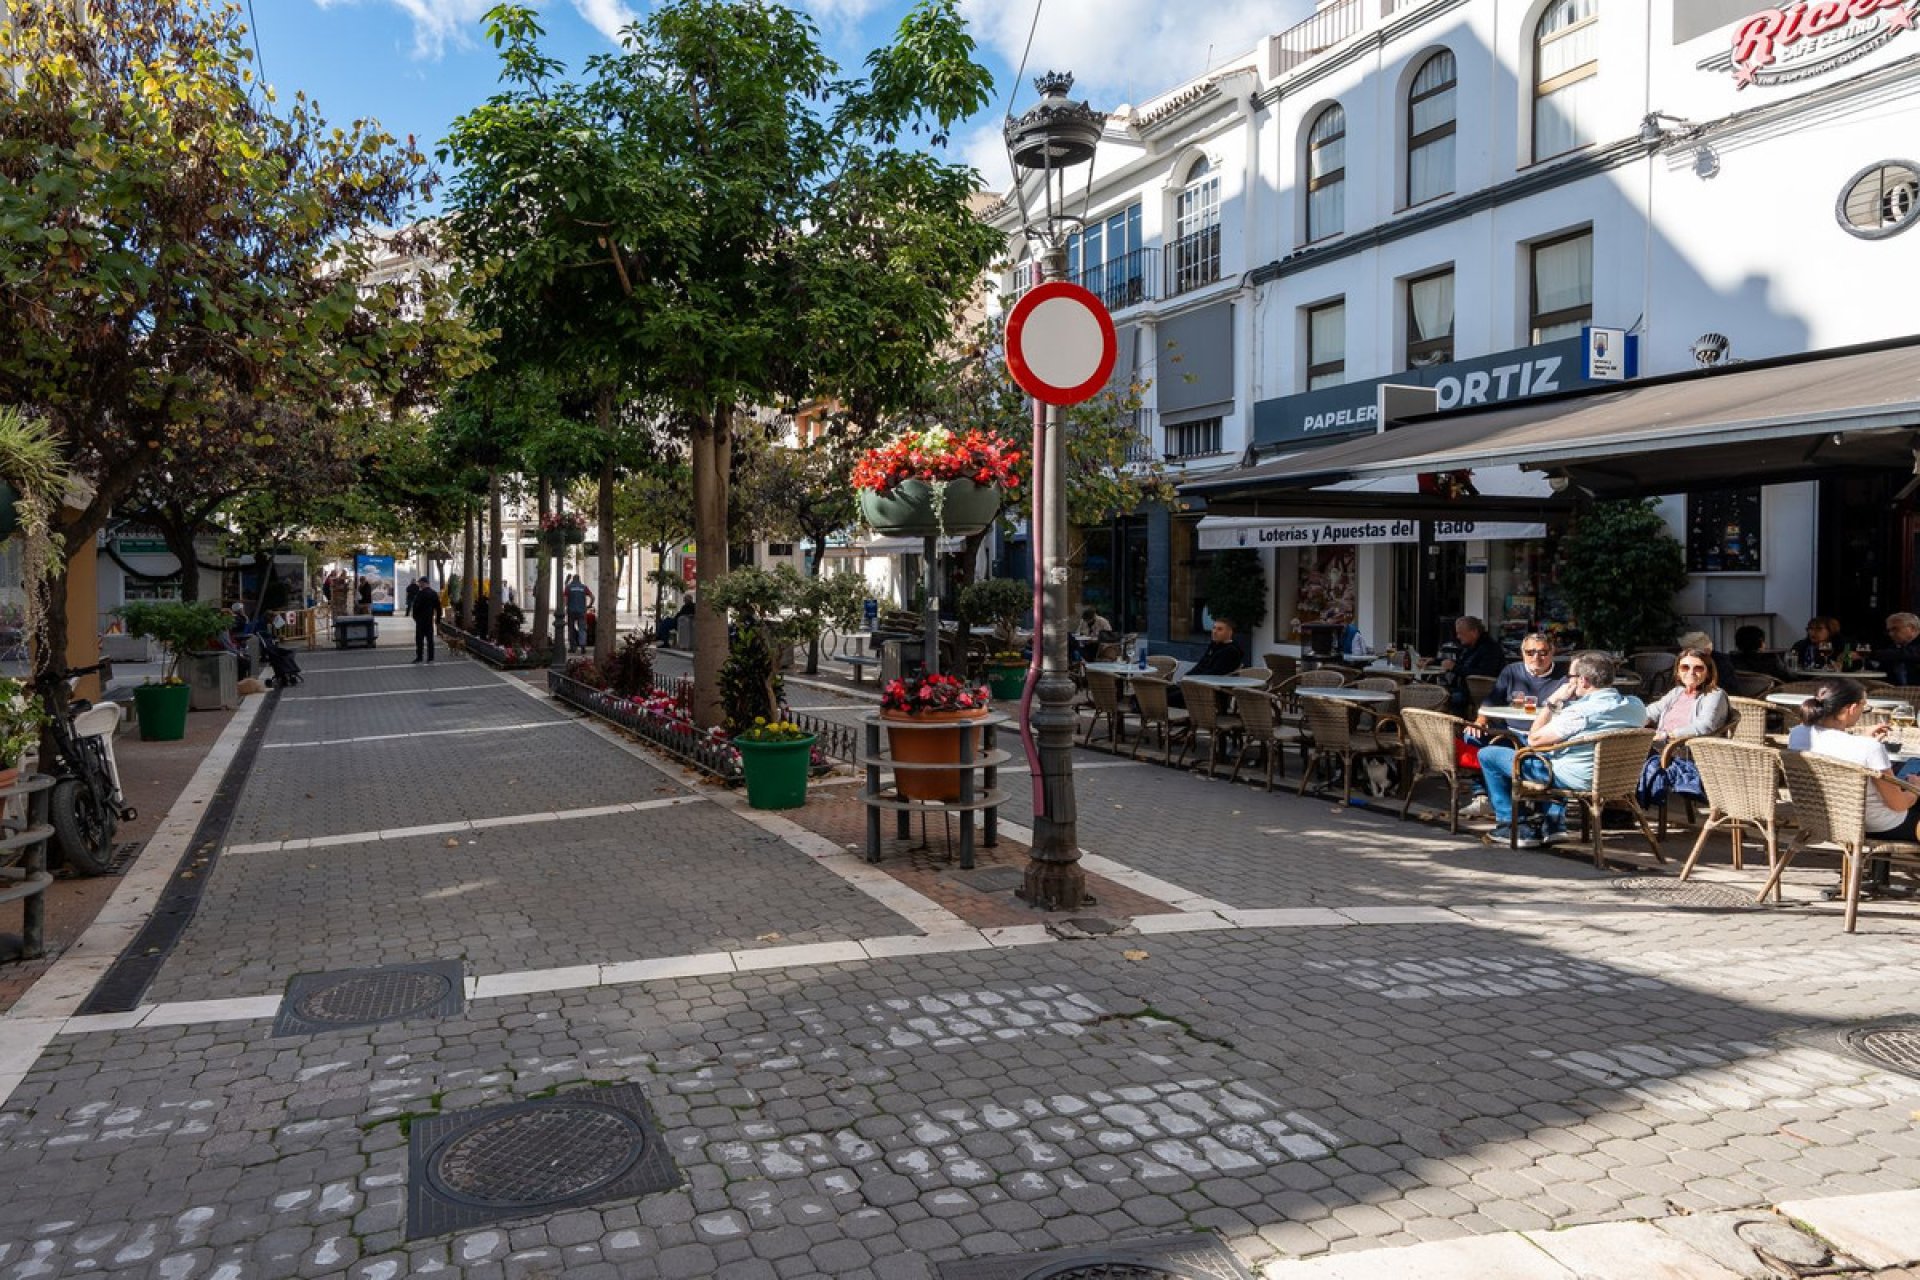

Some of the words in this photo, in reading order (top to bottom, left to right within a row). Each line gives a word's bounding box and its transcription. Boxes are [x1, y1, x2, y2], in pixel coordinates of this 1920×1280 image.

[1304, 405, 1378, 431] PAPELER
[1435, 356, 1562, 409] ORTIZ
[1312, 527, 1320, 543] y
[1323, 523, 1387, 543] Apuestas
[1391, 520, 1414, 536] del
[1434, 521, 1475, 534] tado
